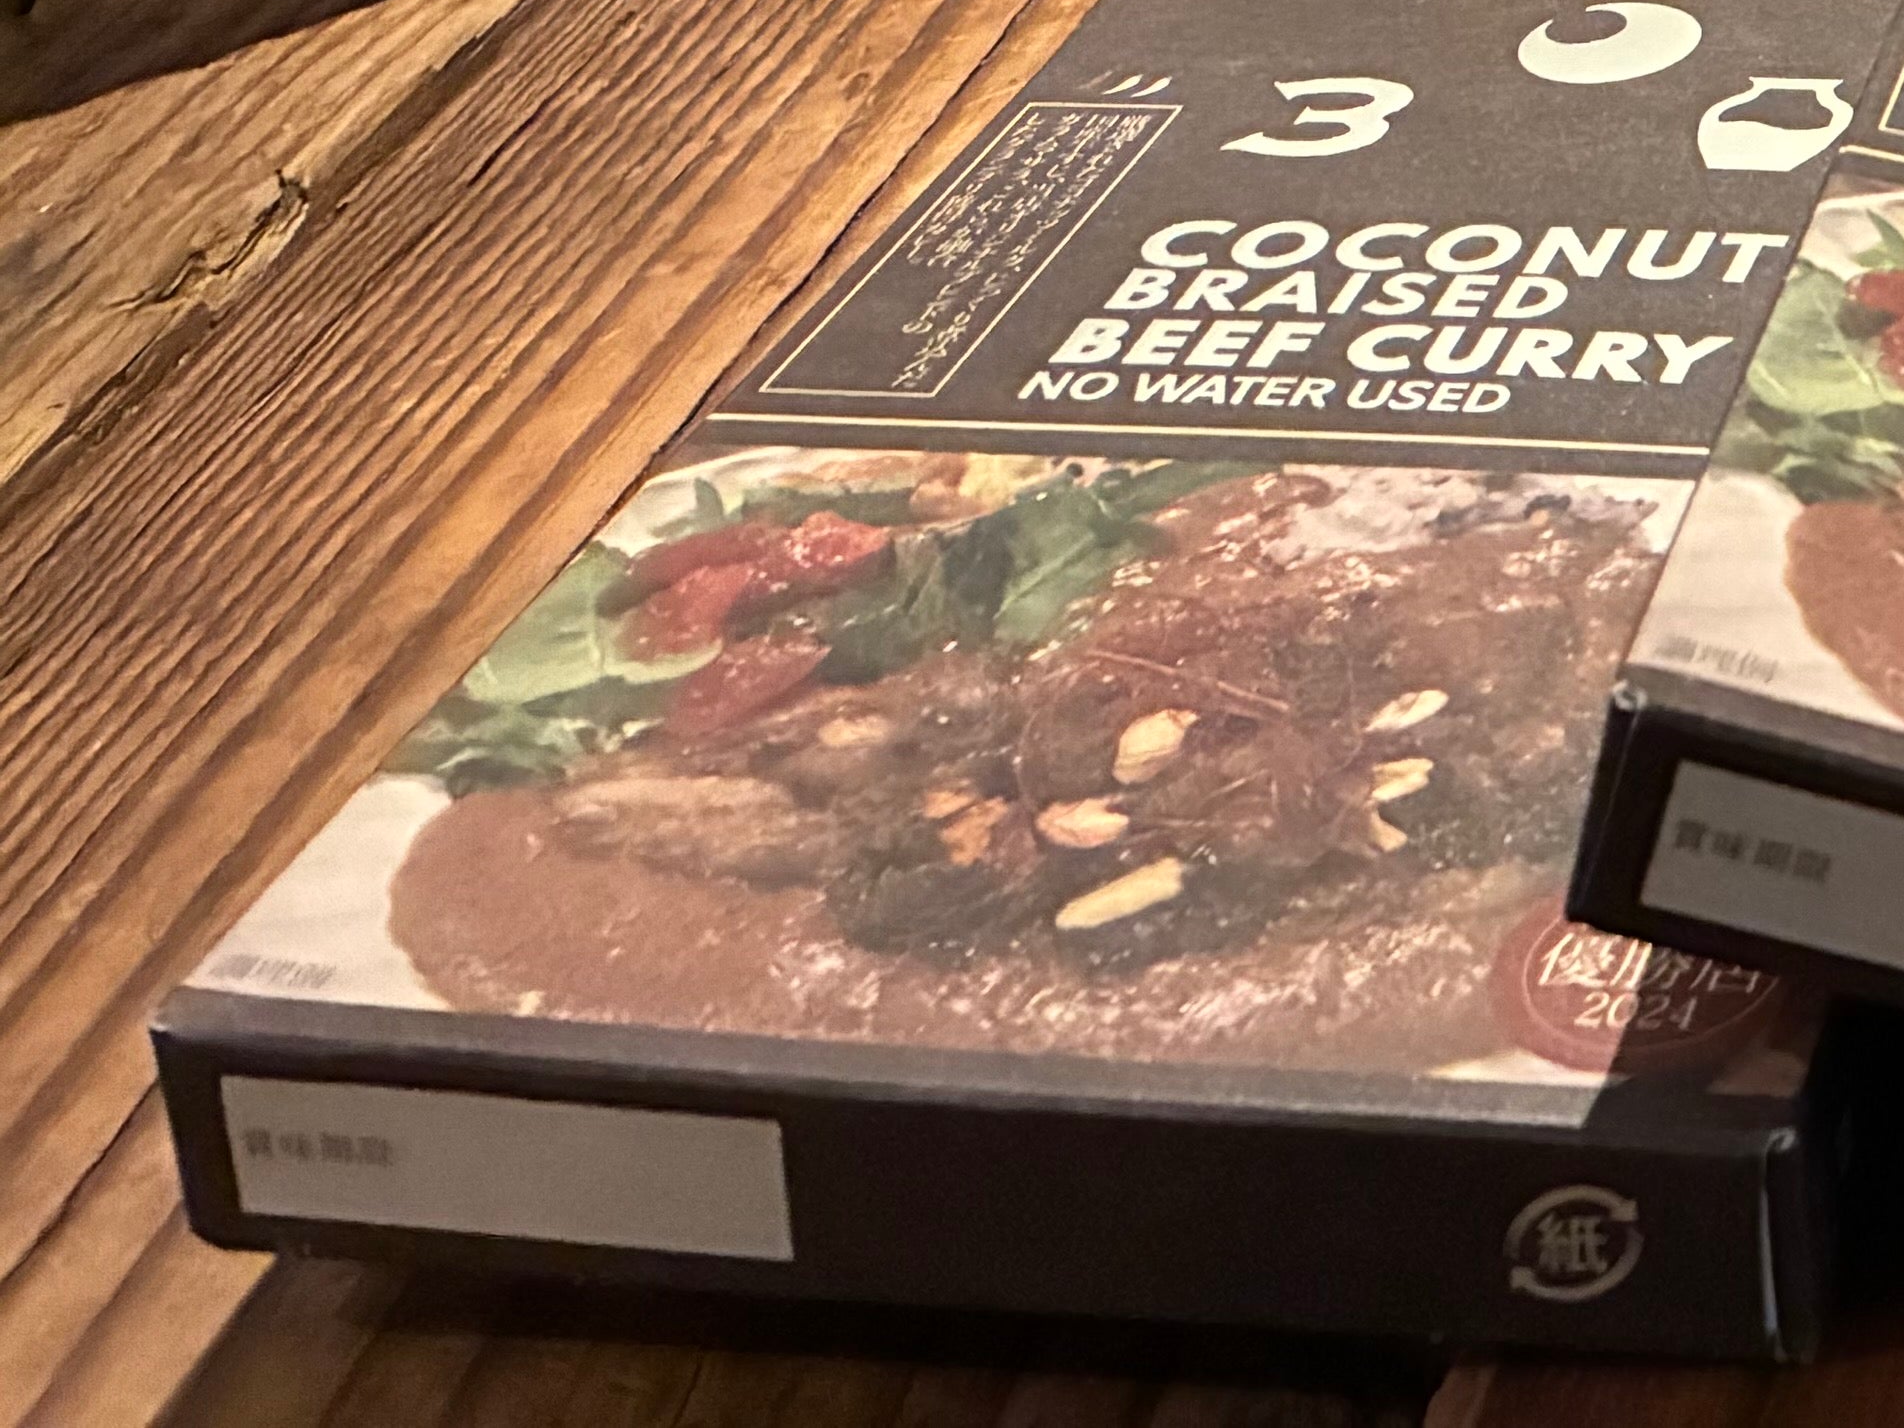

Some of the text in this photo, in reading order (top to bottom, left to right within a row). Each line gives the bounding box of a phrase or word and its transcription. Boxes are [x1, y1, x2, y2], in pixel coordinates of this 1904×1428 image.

[1141, 220, 1789, 283] COCONUT
[1104, 268, 1568, 318] BRAISED
[1049, 319, 1734, 384] BEEF CURRY
[1018, 371, 1510, 412] NO WATER USED
[1574, 992, 1697, 1031] 2024
